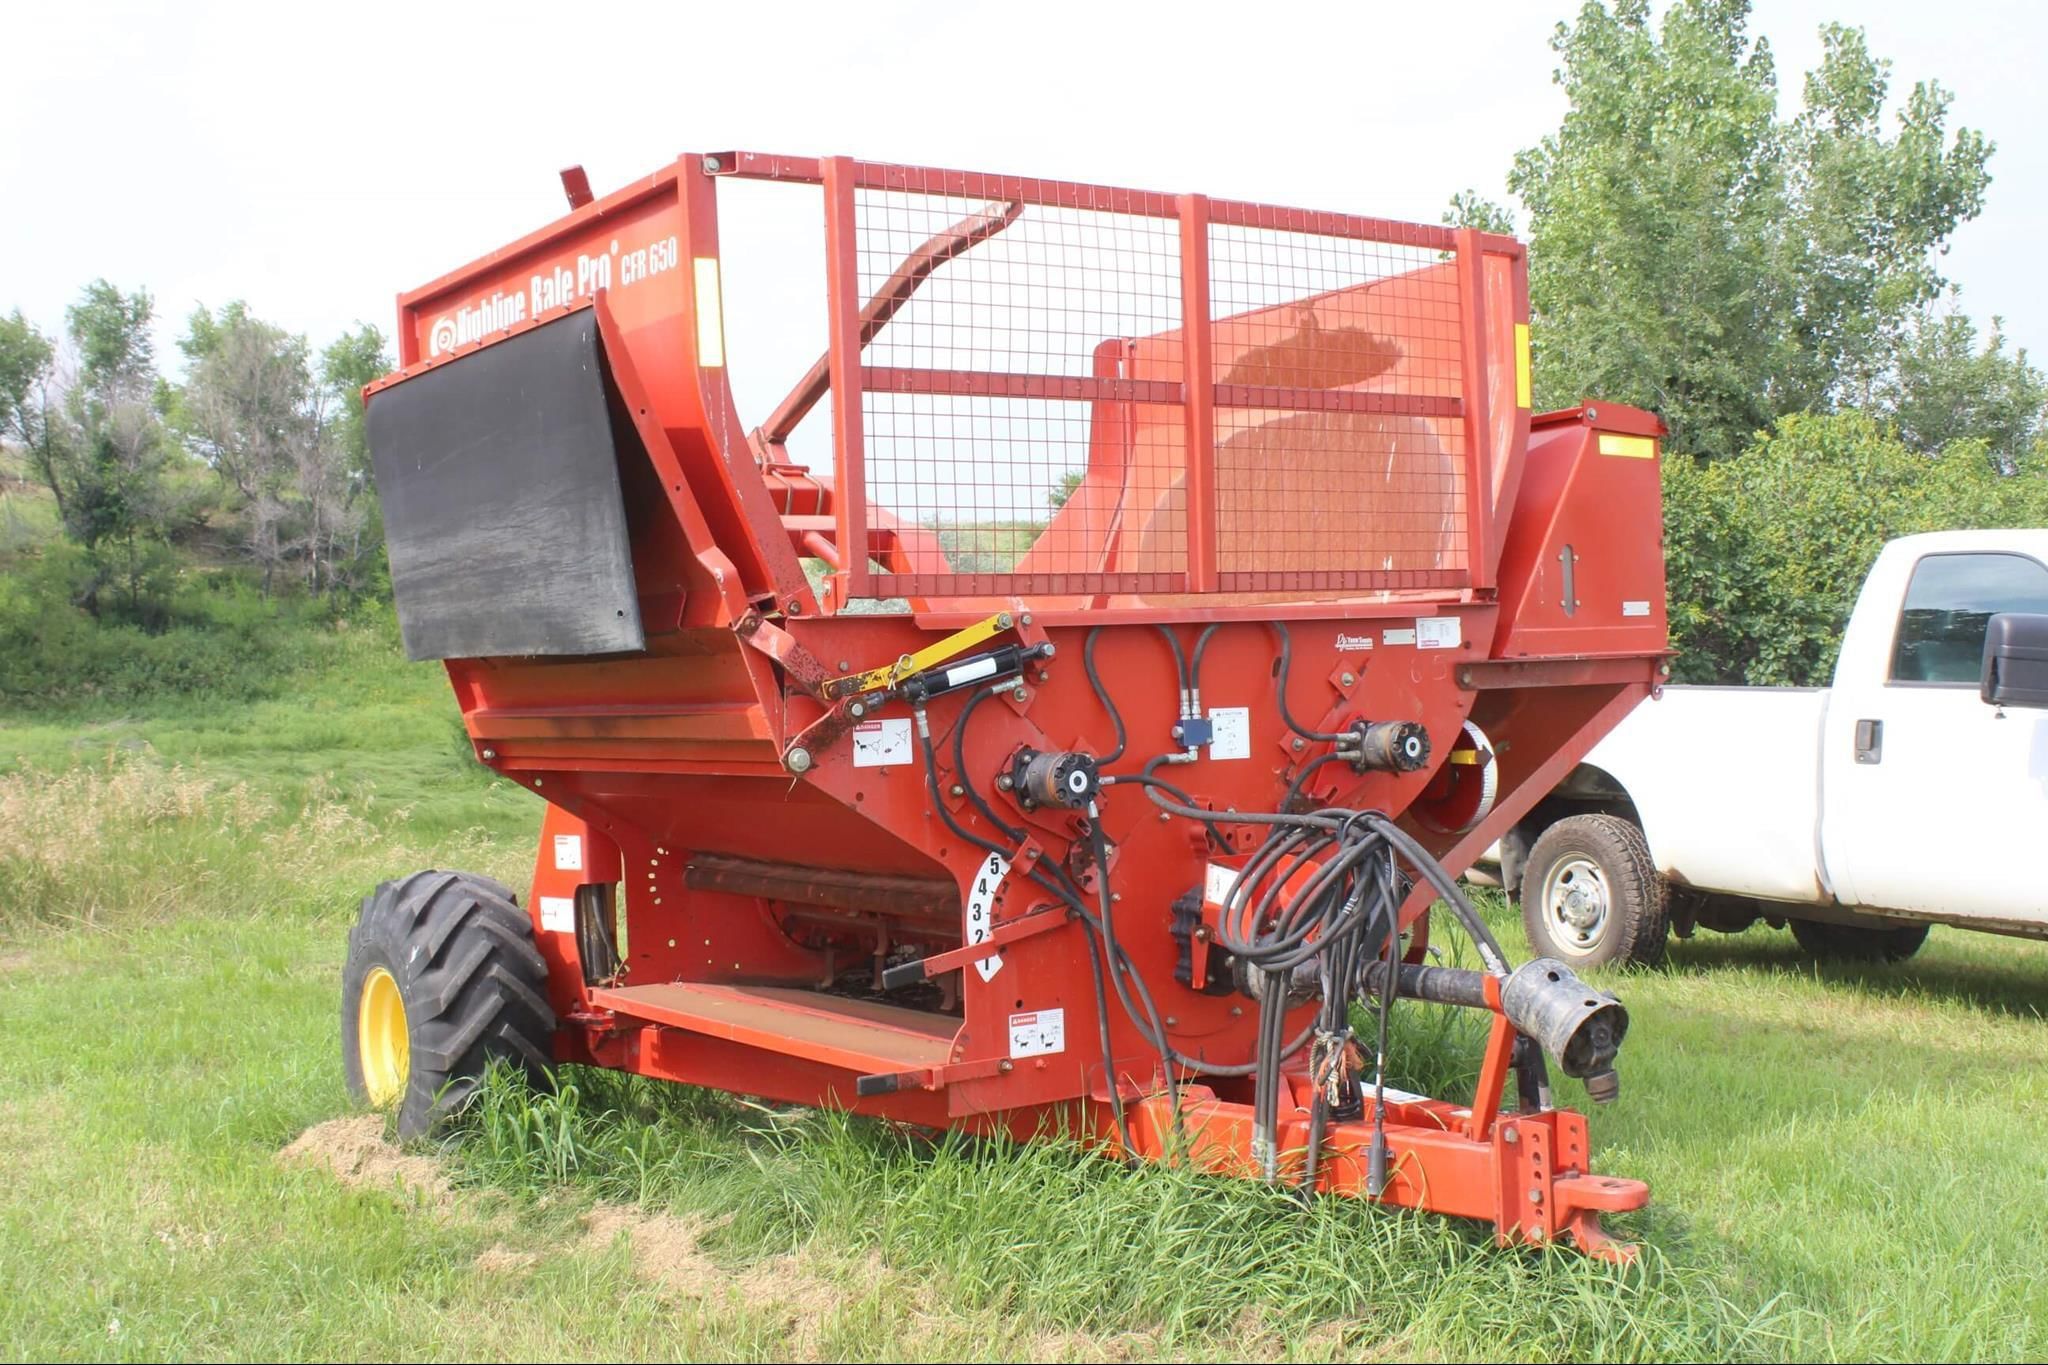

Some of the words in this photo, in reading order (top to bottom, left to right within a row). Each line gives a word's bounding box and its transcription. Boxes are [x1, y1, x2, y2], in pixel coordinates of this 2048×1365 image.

[456, 292, 526, 345] Highline
[531, 267, 574, 313] Bale
[622, 250, 646, 286] CFR
[650, 236, 677, 274] 650
[990, 857, 1000, 875] 5
[978, 878, 988, 896] 4
[973, 903, 982, 921] 3
[975, 929, 984, 944] 2
